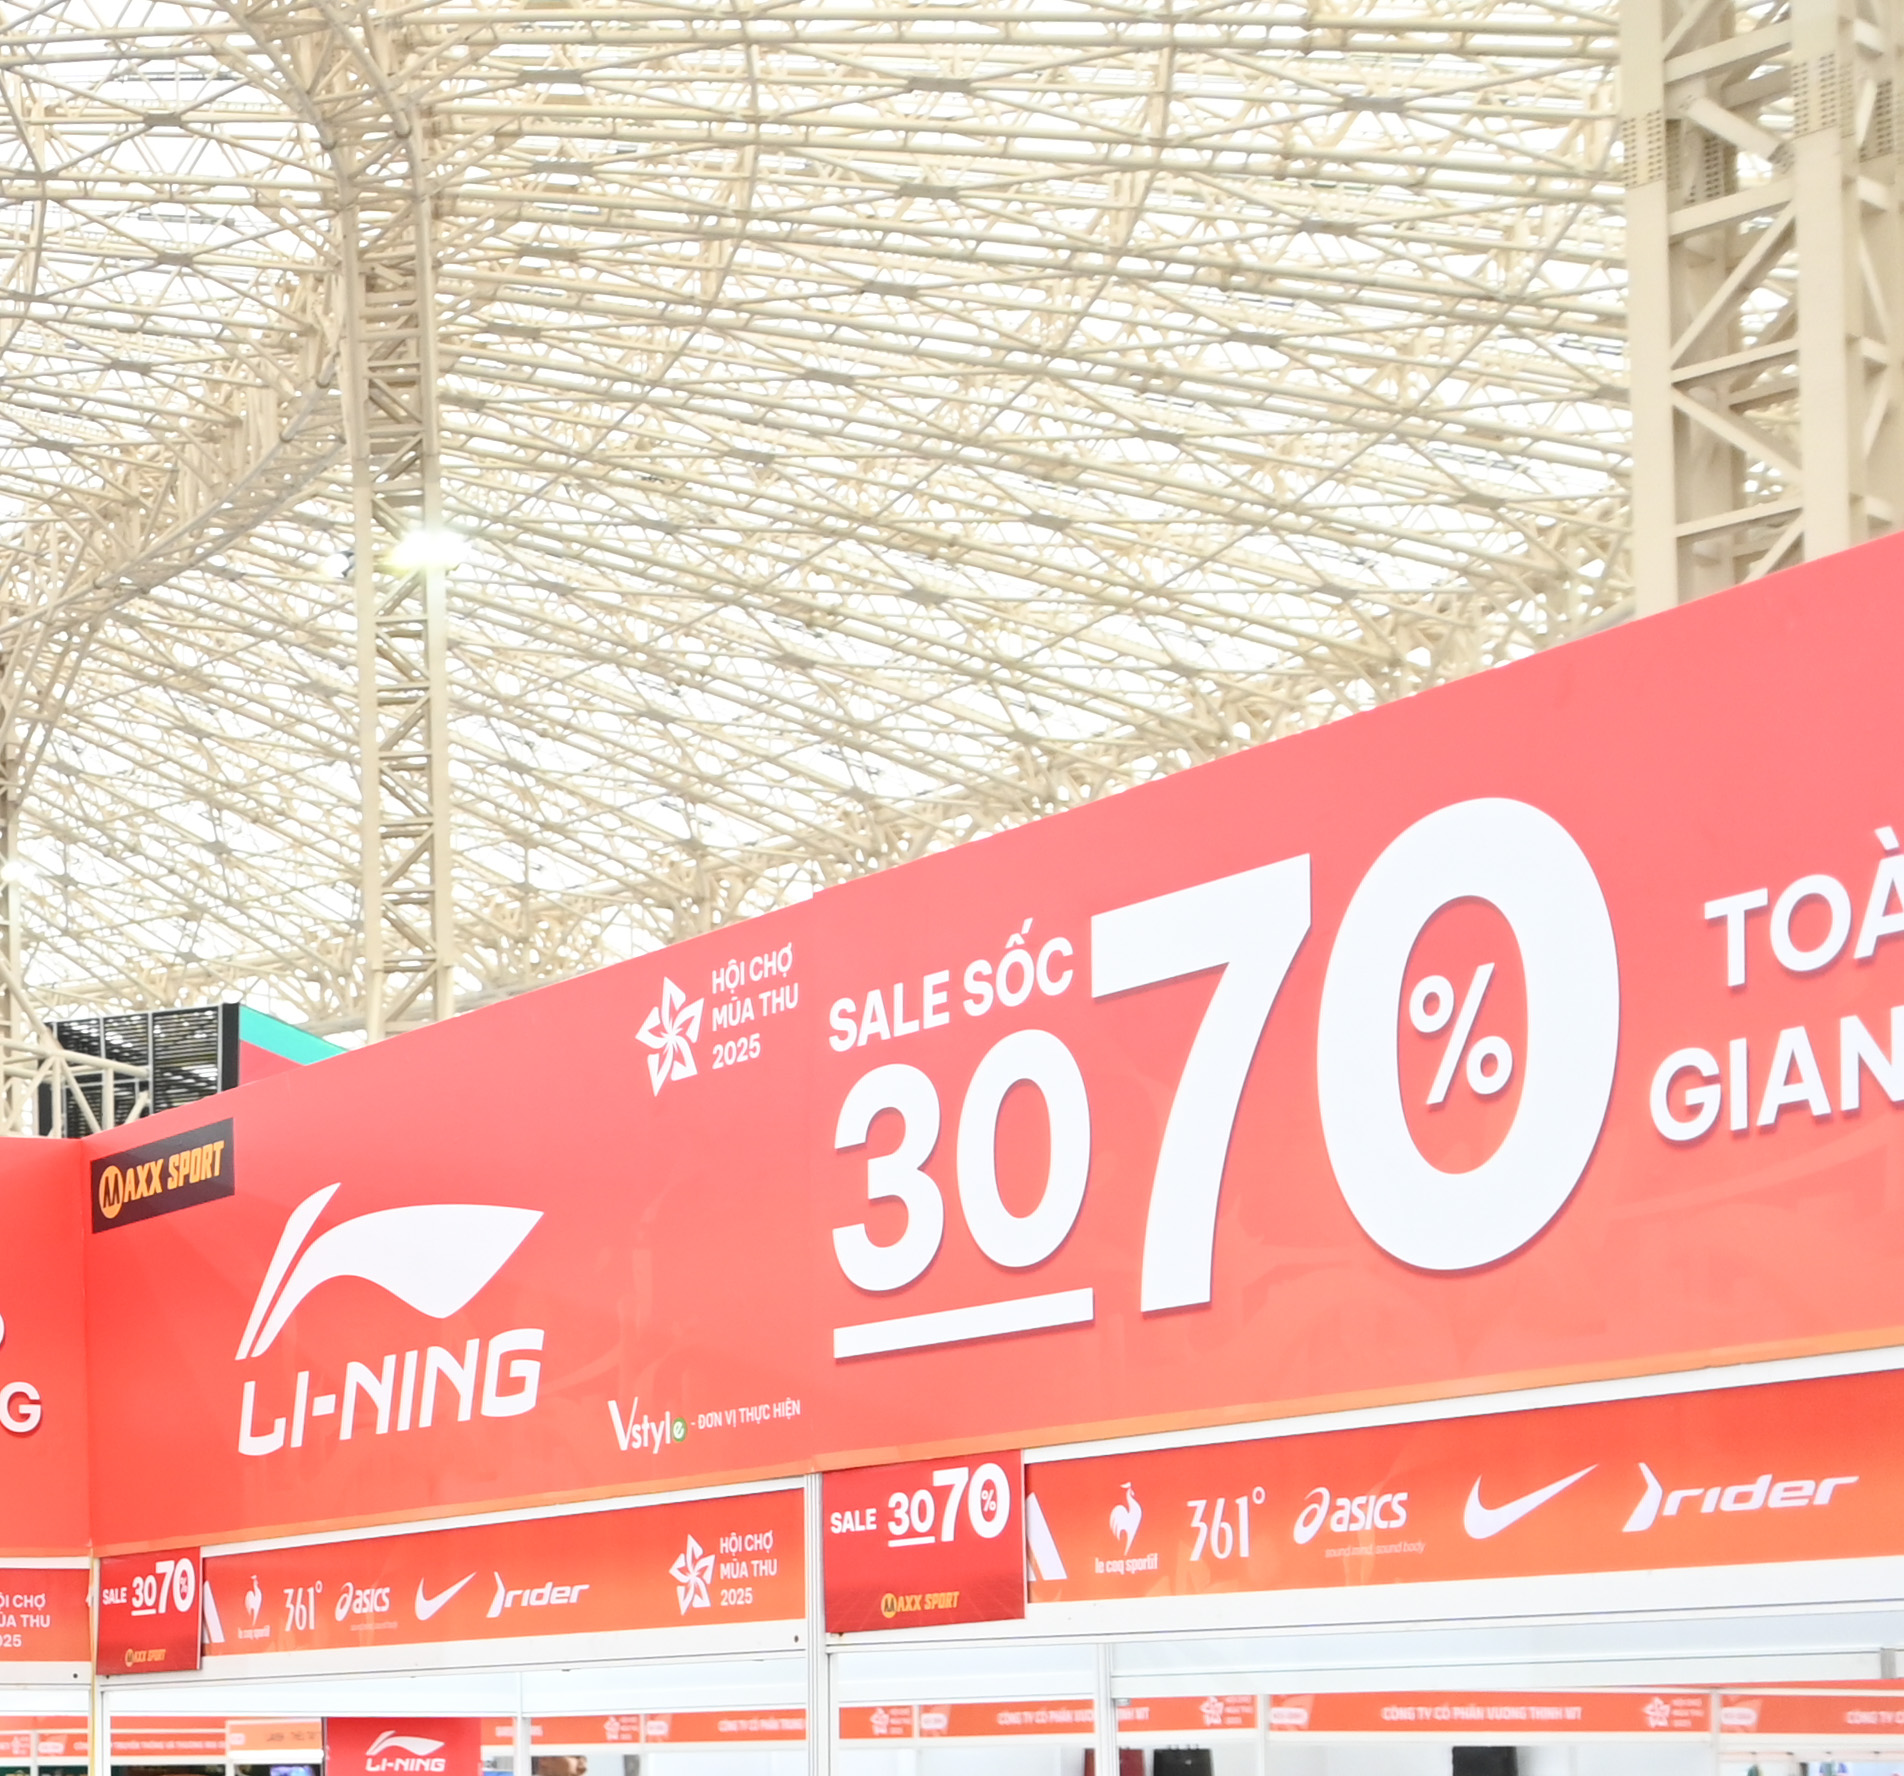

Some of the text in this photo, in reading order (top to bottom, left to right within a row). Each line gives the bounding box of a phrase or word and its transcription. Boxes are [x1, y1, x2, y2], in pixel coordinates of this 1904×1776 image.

[711, 942, 793, 995] HỘI CHỢ
[828, 917, 1074, 1053] SALE SỐC
[758, 982, 799, 1017] THU
[712, 1032, 761, 1070] 2025
[167, 1139, 225, 1192] SPORT
[237, 1328, 545, 1457] LI-NING
[698, 1399, 802, 1431] ĐƠN VỊ THỰC HIỆN
[1662, 1473, 1860, 1517] rider
[830, 1507, 877, 1534] SALE
[1186, 1486, 1266, 1562] 361°
[1332, 1489, 1408, 1532] asics
[719, 1529, 774, 1557] HỘI CHỢ
[750, 1558, 778, 1578] THU
[1095, 1551, 1158, 1575] le coq sportif
[12, 1593, 46, 1611] CHỢ
[102, 1587, 128, 1606] SALE
[503, 1581, 591, 1608] rider
[720, 1586, 754, 1607] 2025
[924, 1589, 960, 1613] SPORT
[19, 1614, 51, 1628] THU
[365, 1757, 447, 1773] LI-NING
